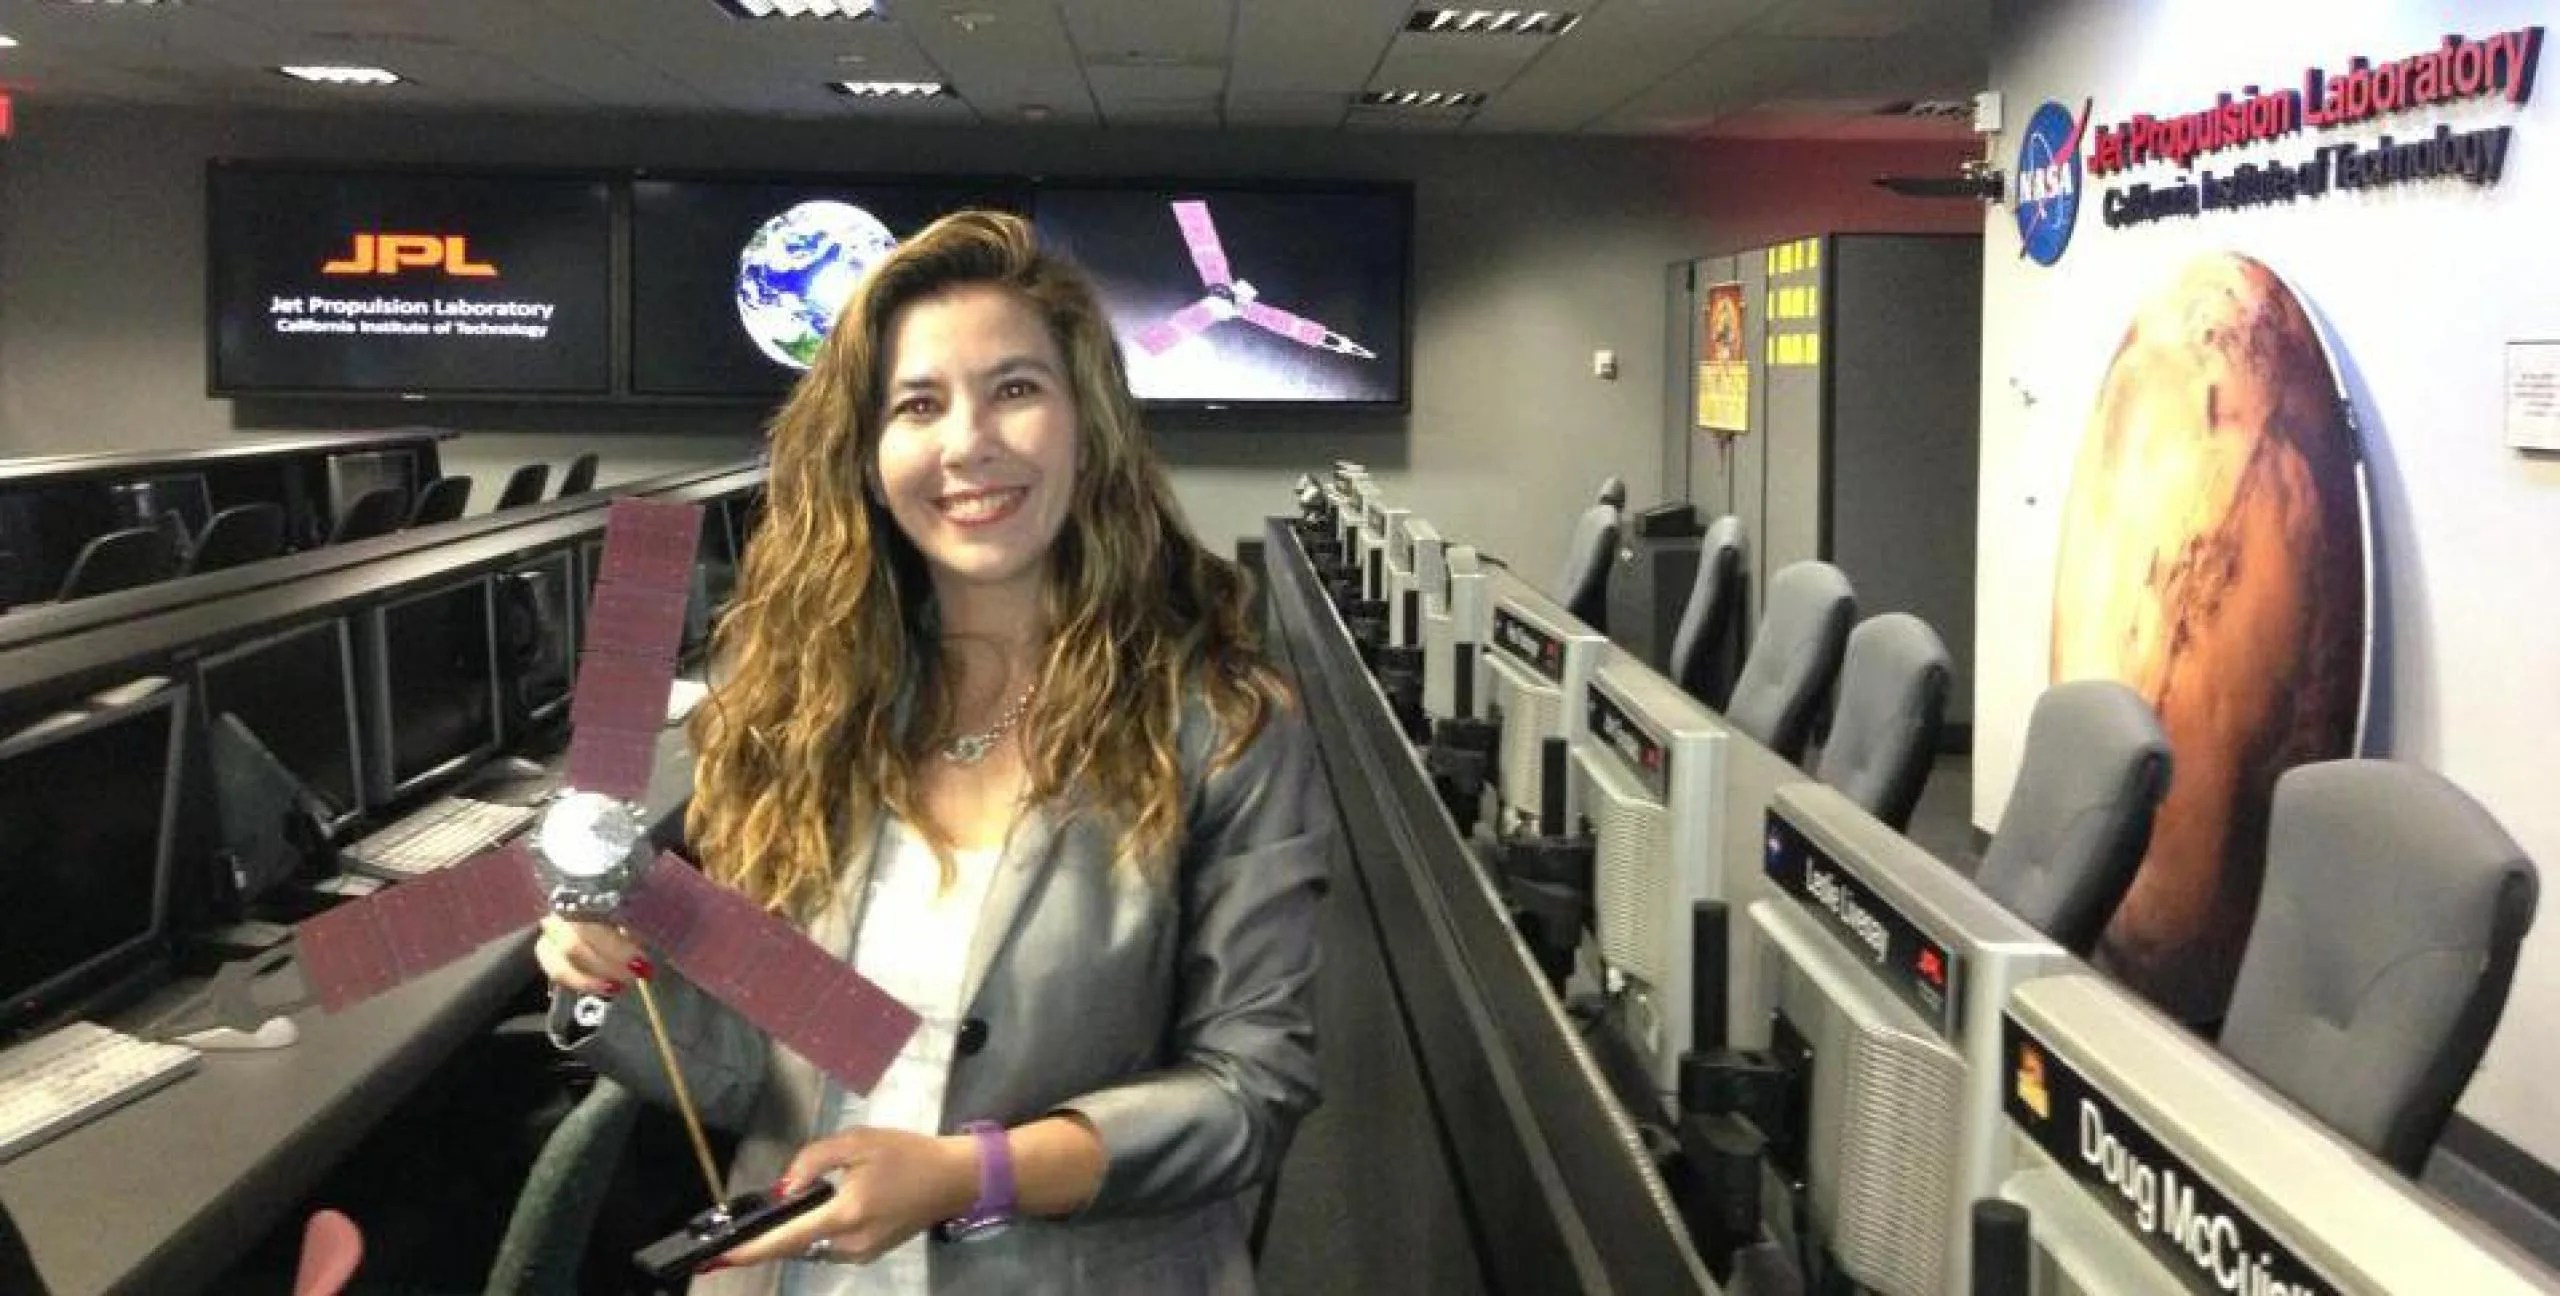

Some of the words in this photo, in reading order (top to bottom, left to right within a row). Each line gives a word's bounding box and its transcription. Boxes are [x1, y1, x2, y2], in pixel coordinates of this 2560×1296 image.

[2087, 124, 2131, 177] Jet
[2132, 86, 2301, 172] Propulsion
[2302, 27, 2544, 132] Laboratory
[2020, 162, 2073, 203] NASA
[2103, 175, 2200, 229] California
[2331, 123, 2512, 187] Technology
[321, 233, 498, 276] JPL
[270, 297, 303, 313] Jet
[309, 297, 429, 317] Propulsion
[434, 299, 555, 319] Laboratory
[277, 319, 356, 333] California
[360, 321, 430, 335] Institute
[432, 321, 452, 335] of
[456, 322, 549, 338] Technology
[2080, 1098, 2155, 1232] Doug
